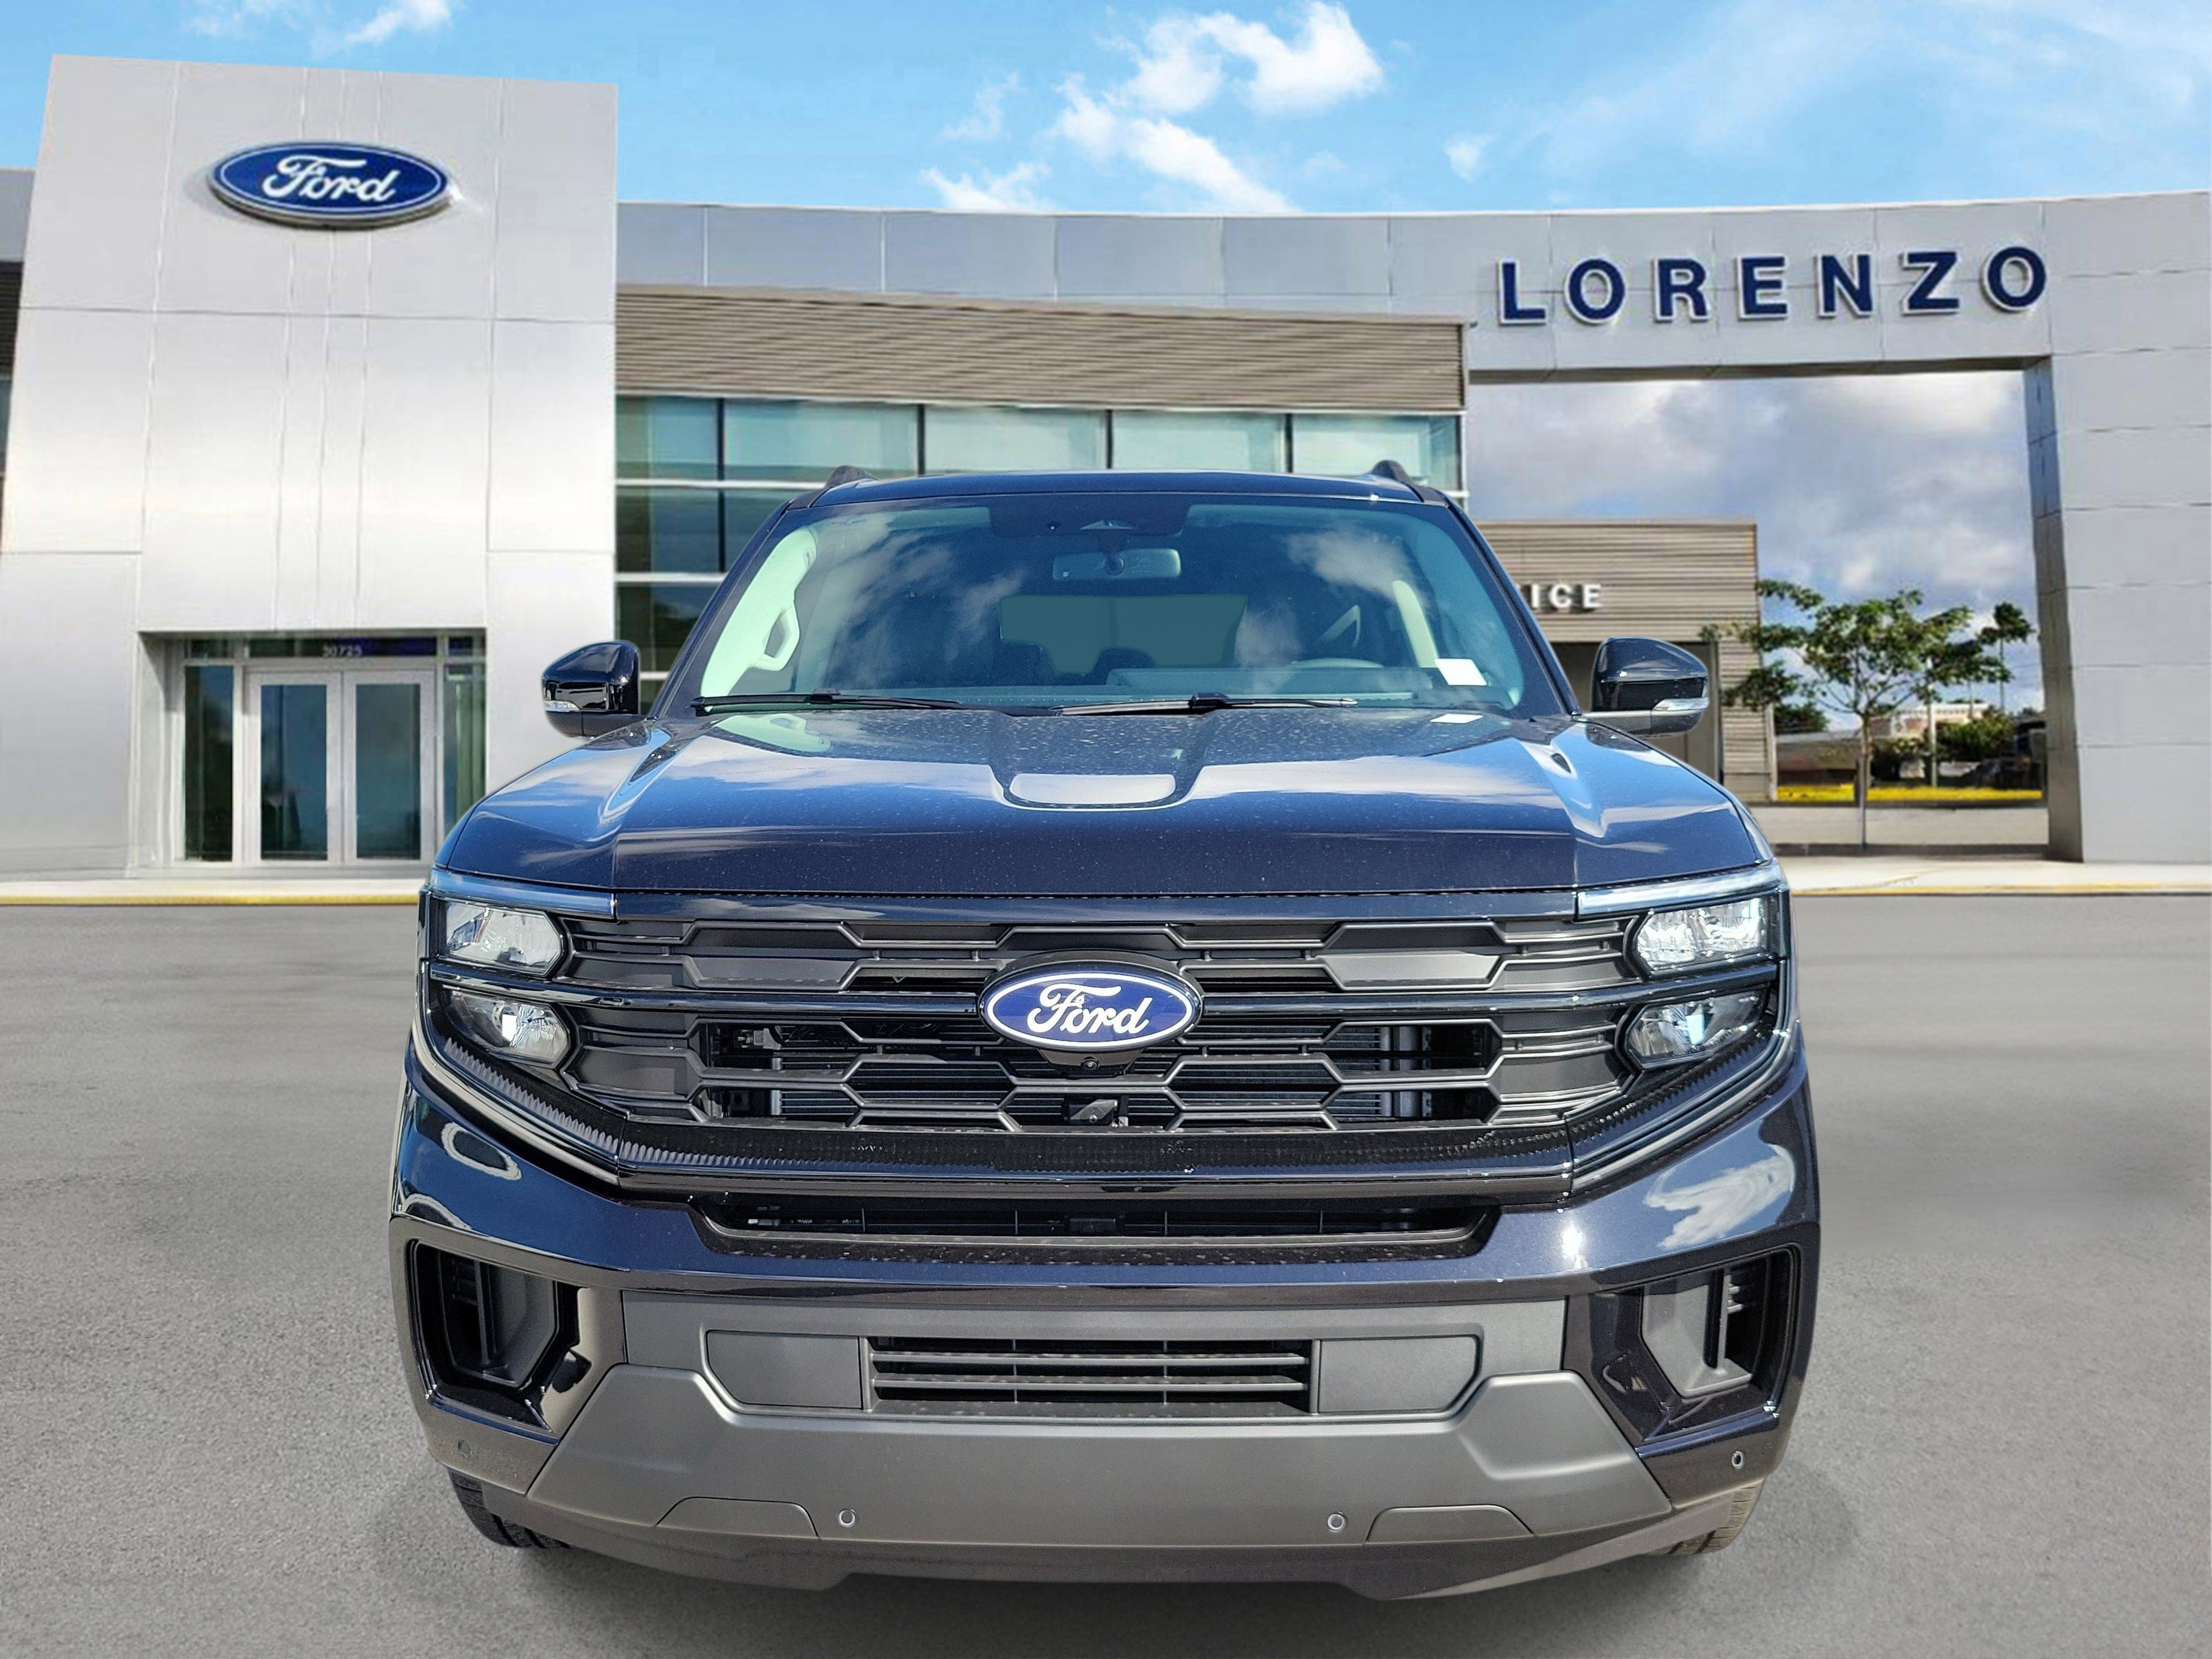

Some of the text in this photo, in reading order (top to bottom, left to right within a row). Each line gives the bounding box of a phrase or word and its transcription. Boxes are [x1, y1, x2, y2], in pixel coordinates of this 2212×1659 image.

[262, 155, 400, 202] Ford
[1497, 246, 2046, 325] LORENZO
[1516, 584, 1602, 609] ICE
[1026, 983, 1154, 1034] Ford
